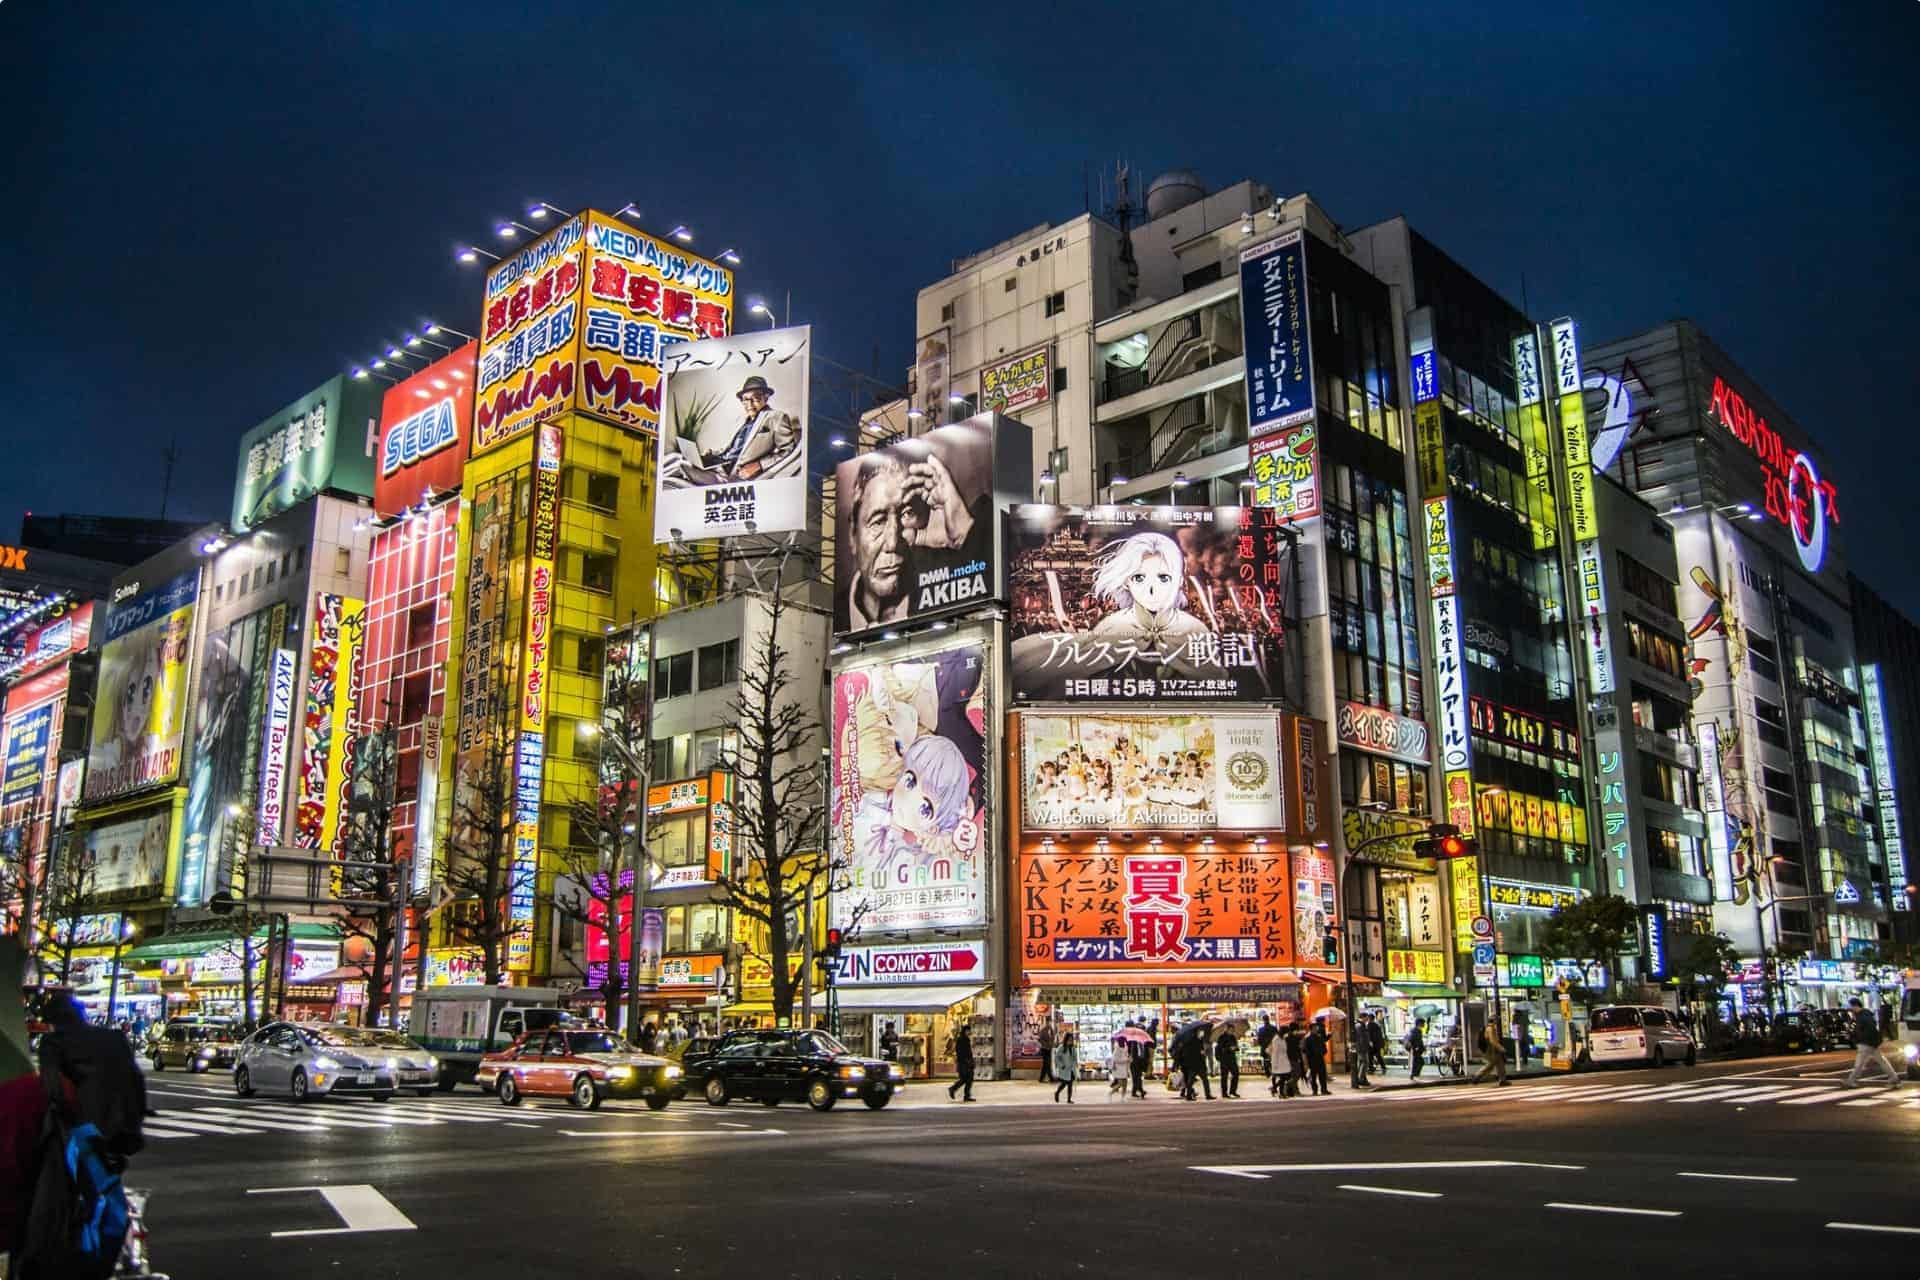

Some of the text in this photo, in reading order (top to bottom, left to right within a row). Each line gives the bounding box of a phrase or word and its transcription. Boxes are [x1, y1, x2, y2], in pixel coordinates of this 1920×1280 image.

[488, 215, 583, 298] MEDIAリサイクル
[592, 223, 730, 295] MEDIAリサイクル
[592, 258, 727, 339] 激安販売
[480, 303, 577, 390] 高額買取
[587, 309, 688, 366] 高額
[1261, 255, 1292, 411] アメニティードリーム
[477, 360, 574, 446] Mulan
[583, 360, 662, 412] Mul
[597, 404, 641, 423] ムーラン
[383, 398, 458, 476] SEGA
[1565, 422, 1579, 462] Yellow
[704, 485, 756, 505] DMM
[1253, 453, 1314, 483] まんが
[703, 502, 756, 524] 英会話
[1571, 470, 1589, 534] Submarine
[918, 560, 987, 588] DMM.make
[918, 574, 988, 611] AKIBA
[276, 653, 293, 704] AKKY
[1040, 631, 1258, 672] アルスラーン戦記
[426, 720, 439, 760] GAME
[1031, 808, 1218, 825] Welcome to Akihabara
[1600, 751, 1628, 889] リバティー
[897, 855, 978, 885] GAME!
[1053, 858, 1074, 935] アイドル
[1075, 858, 1096, 914] アニメ
[1099, 857, 1121, 937] 美少女系
[1192, 858, 1215, 936] フィギュア
[1214, 858, 1235, 914] ホビー
[1236, 857, 1261, 936] 携帯電話
[1024, 858, 1051, 960] AKBもの
[1124, 857, 1191, 962] 買取
[1261, 857, 1286, 960] アップルとか
[838, 949, 951, 981] ZIN COMIC ZIN
[1055, 938, 1260, 961] チケット 大黒屋
